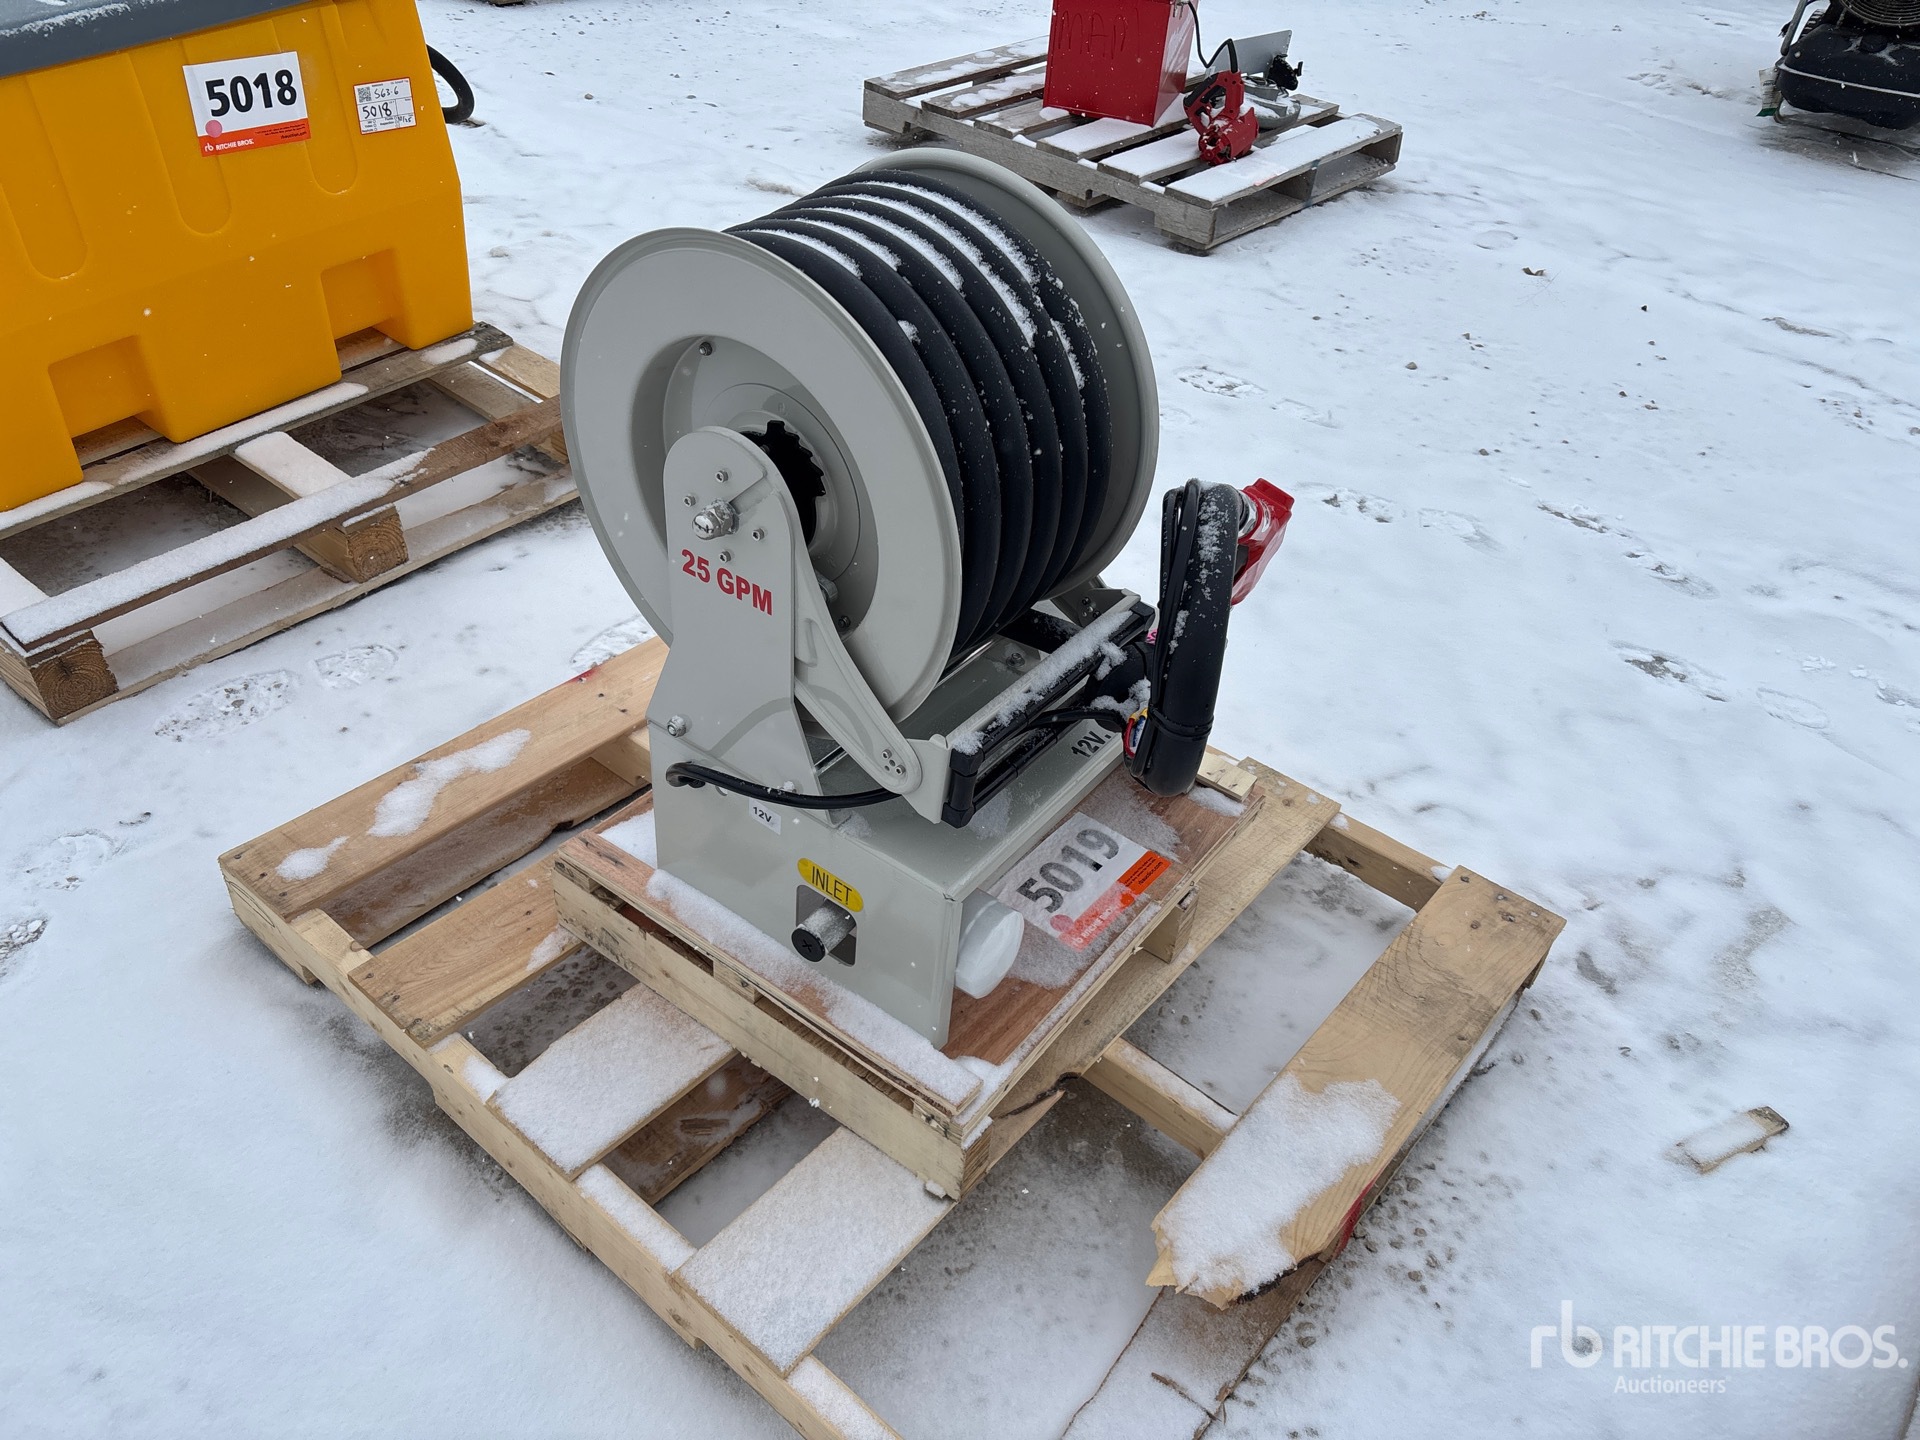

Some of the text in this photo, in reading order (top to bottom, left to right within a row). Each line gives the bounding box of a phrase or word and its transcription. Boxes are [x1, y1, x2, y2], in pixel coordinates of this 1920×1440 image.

[205, 69, 297, 117] 5018
[362, 102, 392, 119] 5018
[204, 143, 214, 152] rb
[215, 141, 237, 151] RITCHIE
[681, 549, 773, 616] 25 GPM
[811, 866, 853, 906] INLET
[1016, 828, 1120, 914] 5019
